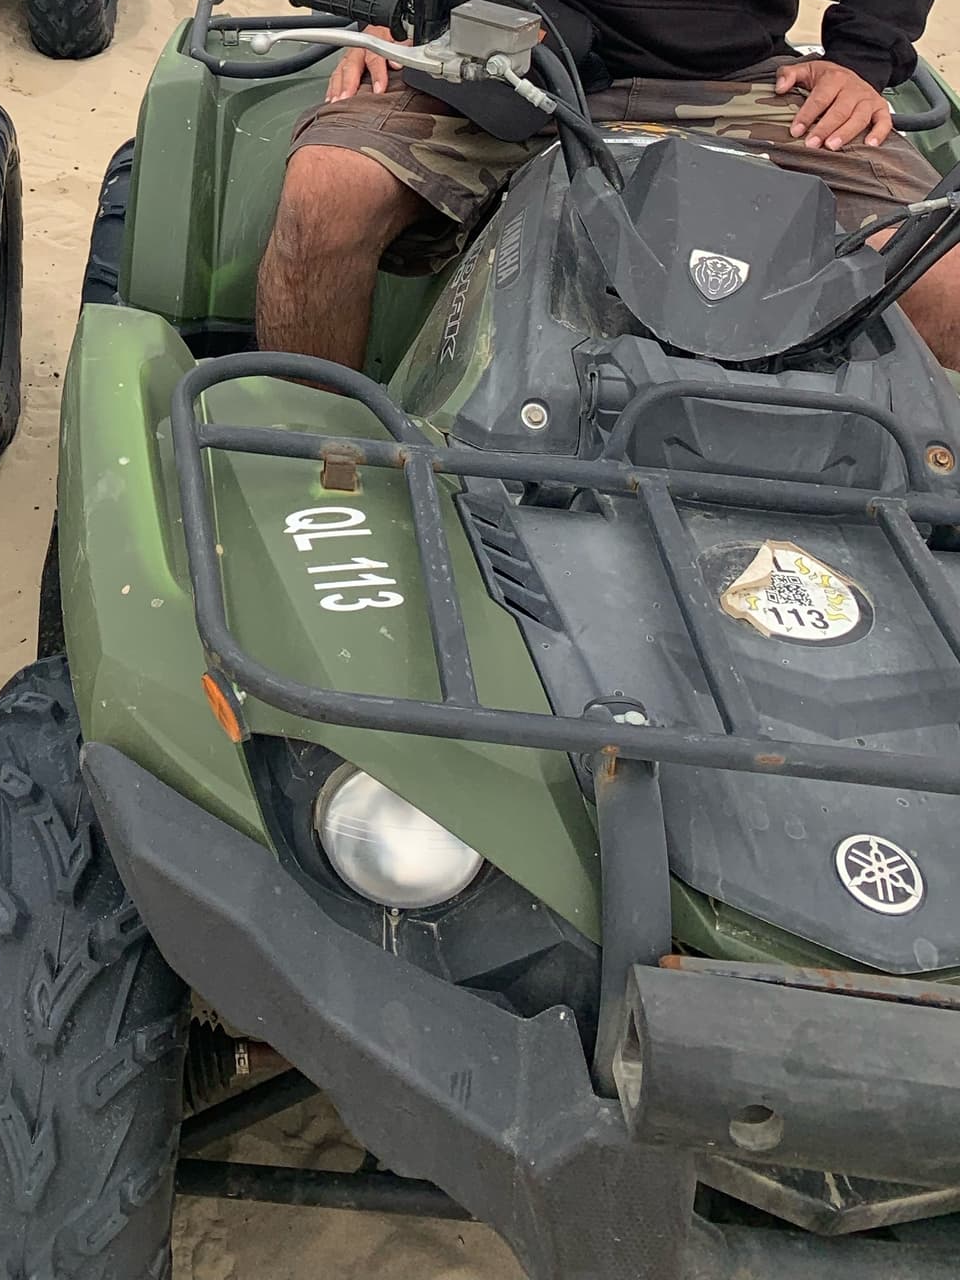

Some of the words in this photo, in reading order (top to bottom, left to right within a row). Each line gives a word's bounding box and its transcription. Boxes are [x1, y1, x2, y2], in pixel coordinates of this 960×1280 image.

[497, 210, 525, 284] YAMAHA
[283, 506, 373, 552] QL
[307, 557, 405, 612] 113
[772, 556, 796, 573] L
[767, 606, 830, 630] 113
